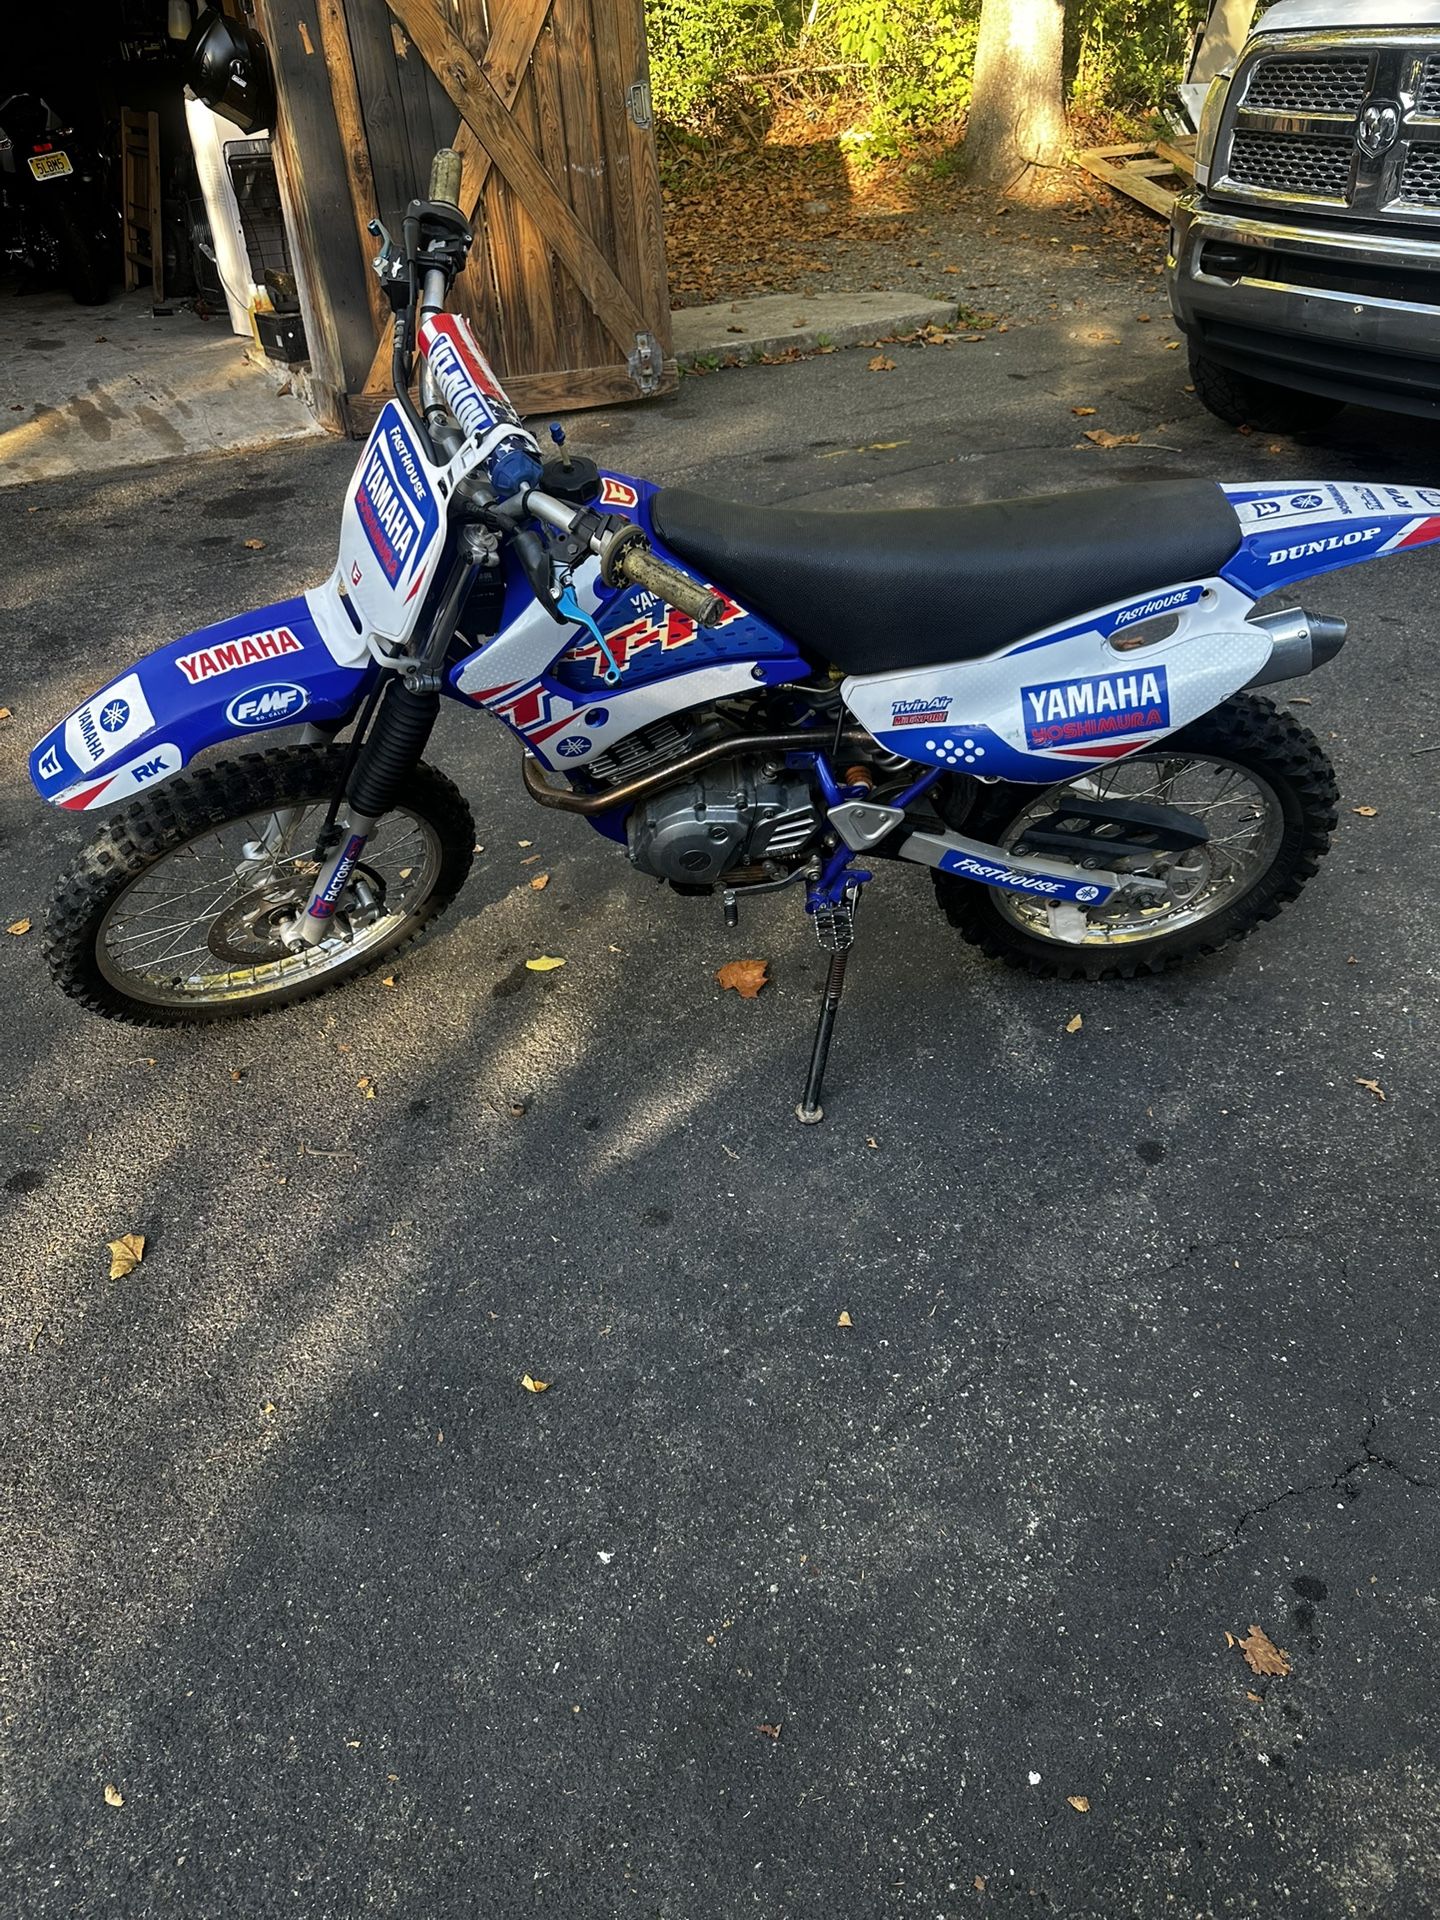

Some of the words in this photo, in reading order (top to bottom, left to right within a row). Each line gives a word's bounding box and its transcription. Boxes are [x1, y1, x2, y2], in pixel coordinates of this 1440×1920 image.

[389, 425, 427, 500] FASTHOUSE
[365, 452, 414, 562] YAMAHA
[1267, 527, 1382, 566] DUNLOP
[1114, 590, 1191, 626] FASTHOUSE
[179, 629, 300, 681] YAMAHA
[237, 689, 298, 720] FMF
[892, 699, 928, 715] Twin
[928, 696, 953, 711] Air
[1028, 673, 1162, 723] YAMAHA
[76, 706, 105, 762] YAMAHA
[1031, 709, 1163, 744] YOSHIMURA
[131, 755, 171, 783] RK
[325, 858, 354, 902] FACTORY
[953, 858, 1066, 894] FASTHOUSE
